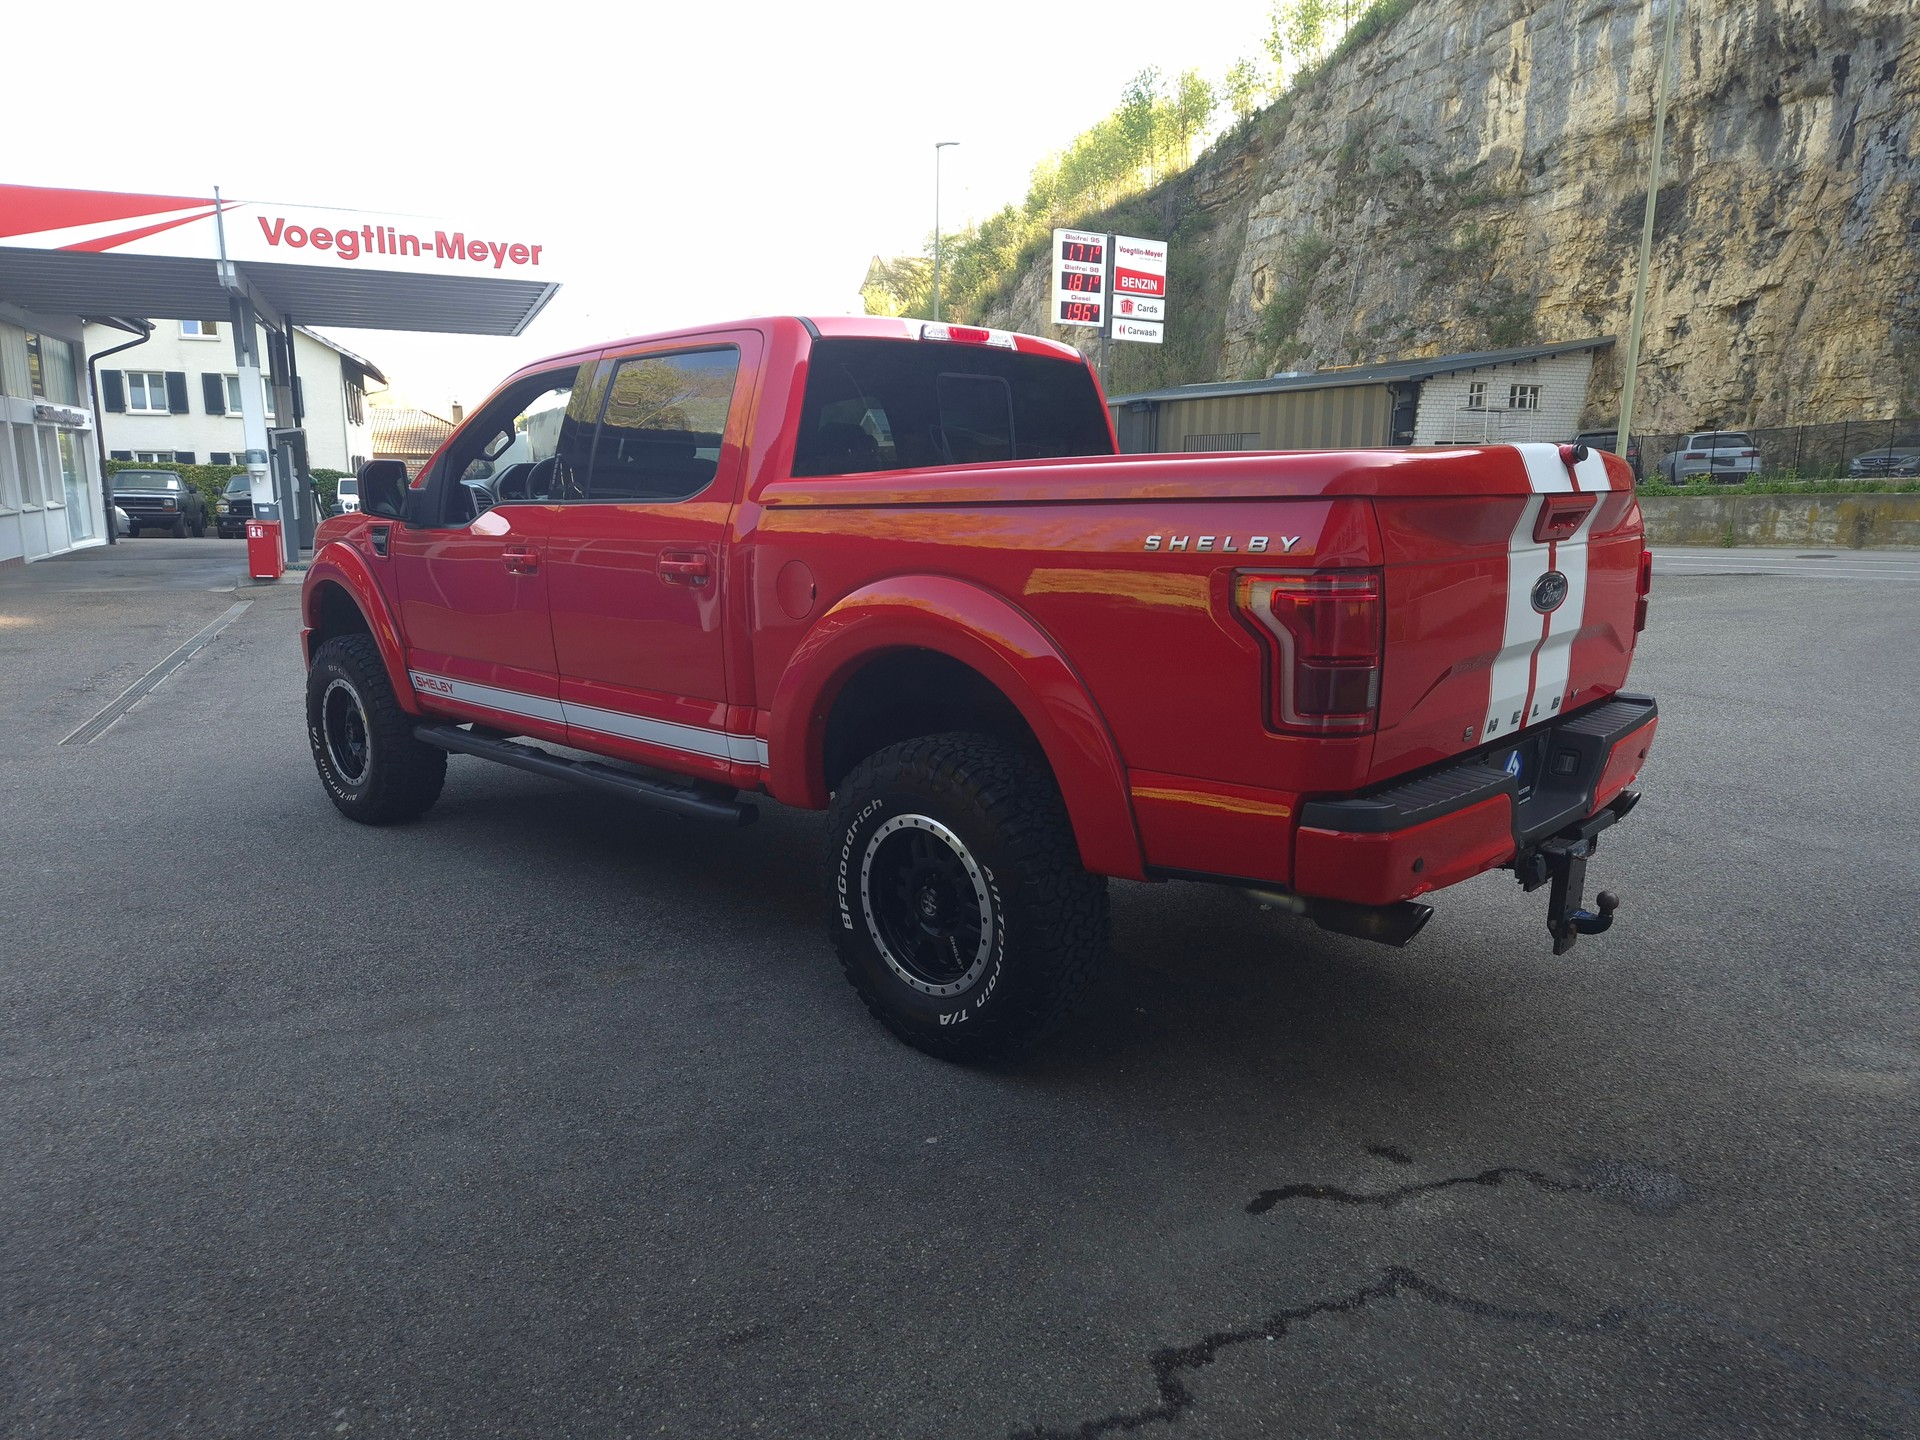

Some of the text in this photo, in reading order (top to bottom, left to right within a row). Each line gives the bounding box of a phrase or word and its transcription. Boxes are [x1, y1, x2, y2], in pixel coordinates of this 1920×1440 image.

[257, 216, 543, 269] Voegtlin-Meyer
[1065, 233, 1100, 244] Bleifrei 95
[1119, 245, 1164, 259] Voegtlin-Meyer
[1064, 263, 1088, 272] Bleifrei
[1121, 276, 1158, 291] BENZIN
[1071, 294, 1091, 302] Diesel
[1137, 303, 1158, 314] Cards
[1127, 326, 1157, 337] Carwash
[1144, 535, 1301, 552] SHELBY
[416, 675, 454, 694] SHELBY
[1463, 688, 1579, 742] SHELBY
[837, 799, 883, 930] BFGoodrich
[939, 1009, 969, 1025] T/A
